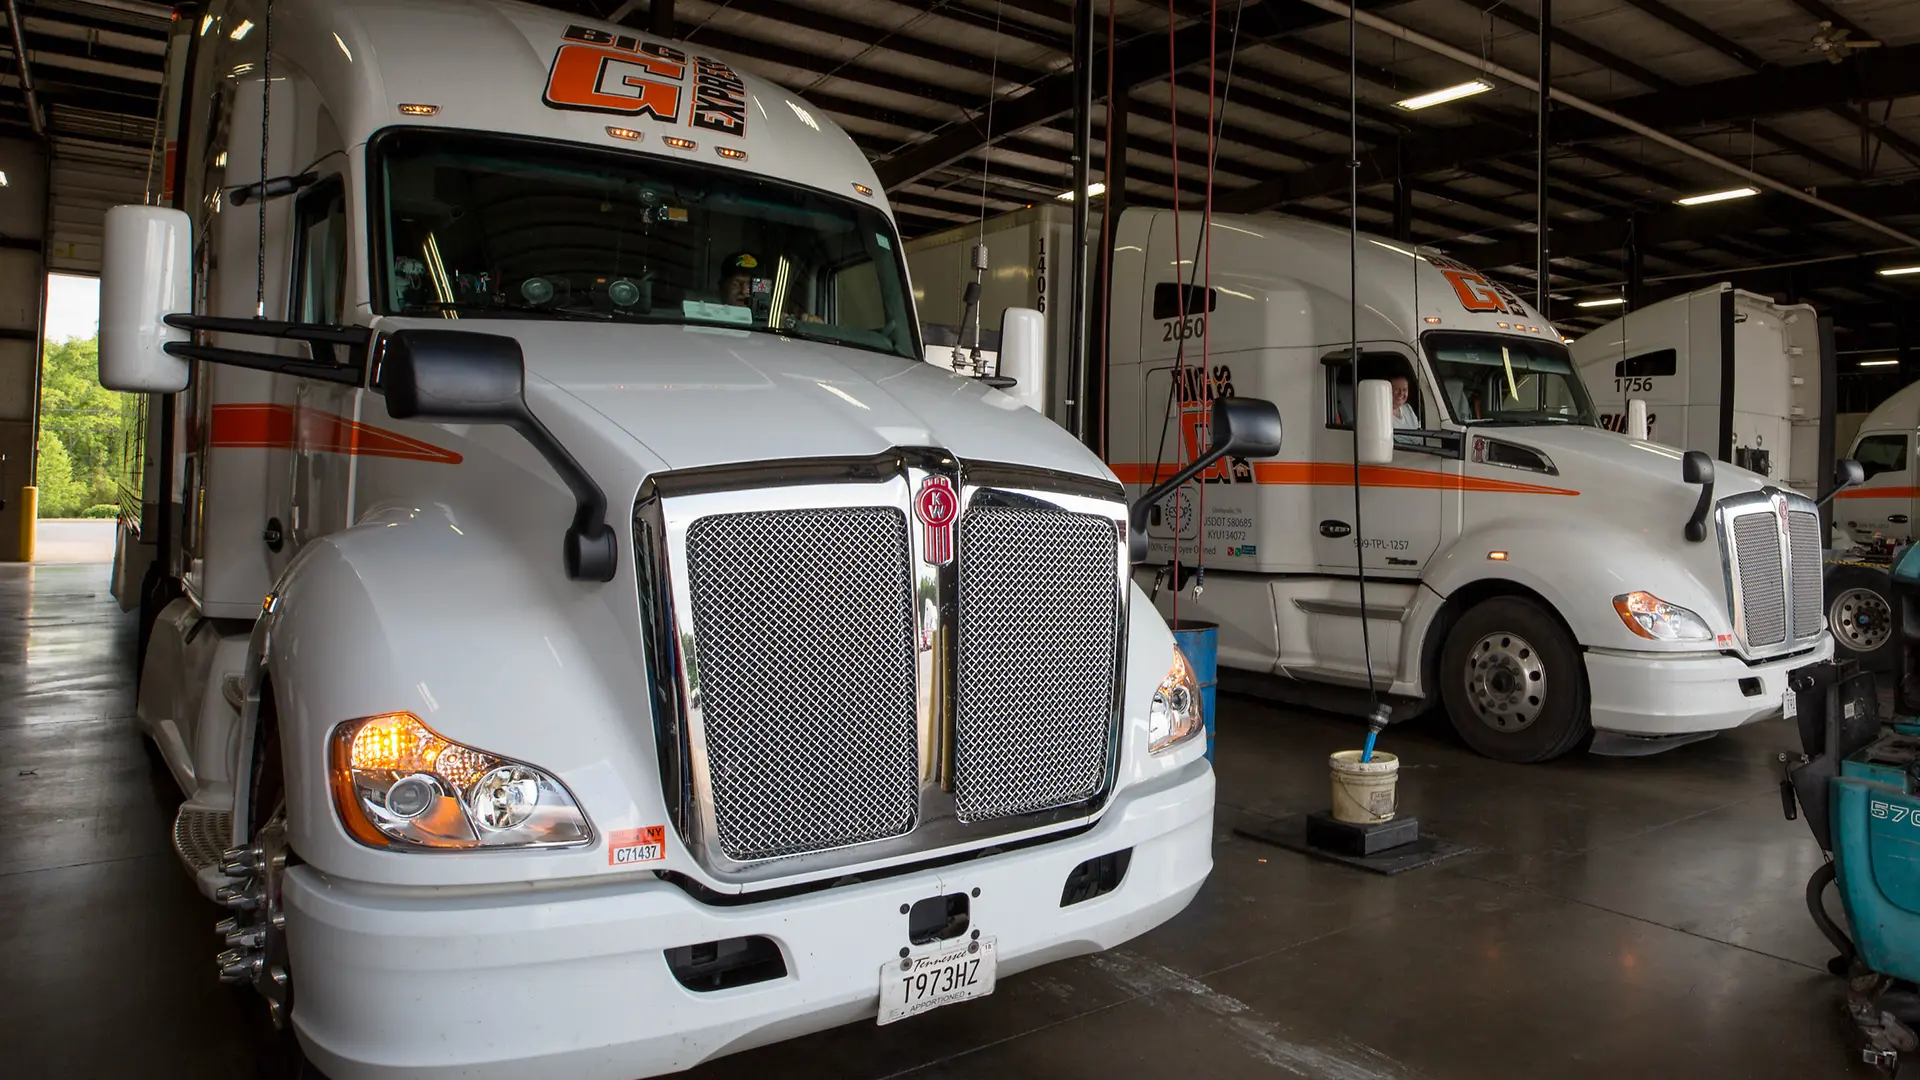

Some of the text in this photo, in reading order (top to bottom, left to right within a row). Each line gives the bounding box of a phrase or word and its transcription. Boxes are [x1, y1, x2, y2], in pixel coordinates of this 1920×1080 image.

[561, 23, 689, 65] BIG
[541, 44, 685, 124] G
[1038, 237, 1046, 313] 1406
[1441, 269, 1509, 314] G
[1163, 318, 1205, 342] 2050
[1614, 377, 1653, 392] 1756
[647, 827, 661, 837] NY
[617, 845, 657, 862] C71437
[913, 949, 967, 973] Tennessee
[903, 958, 980, 1004] T973HZ
[910, 990, 965, 1013] APPORTIONED
